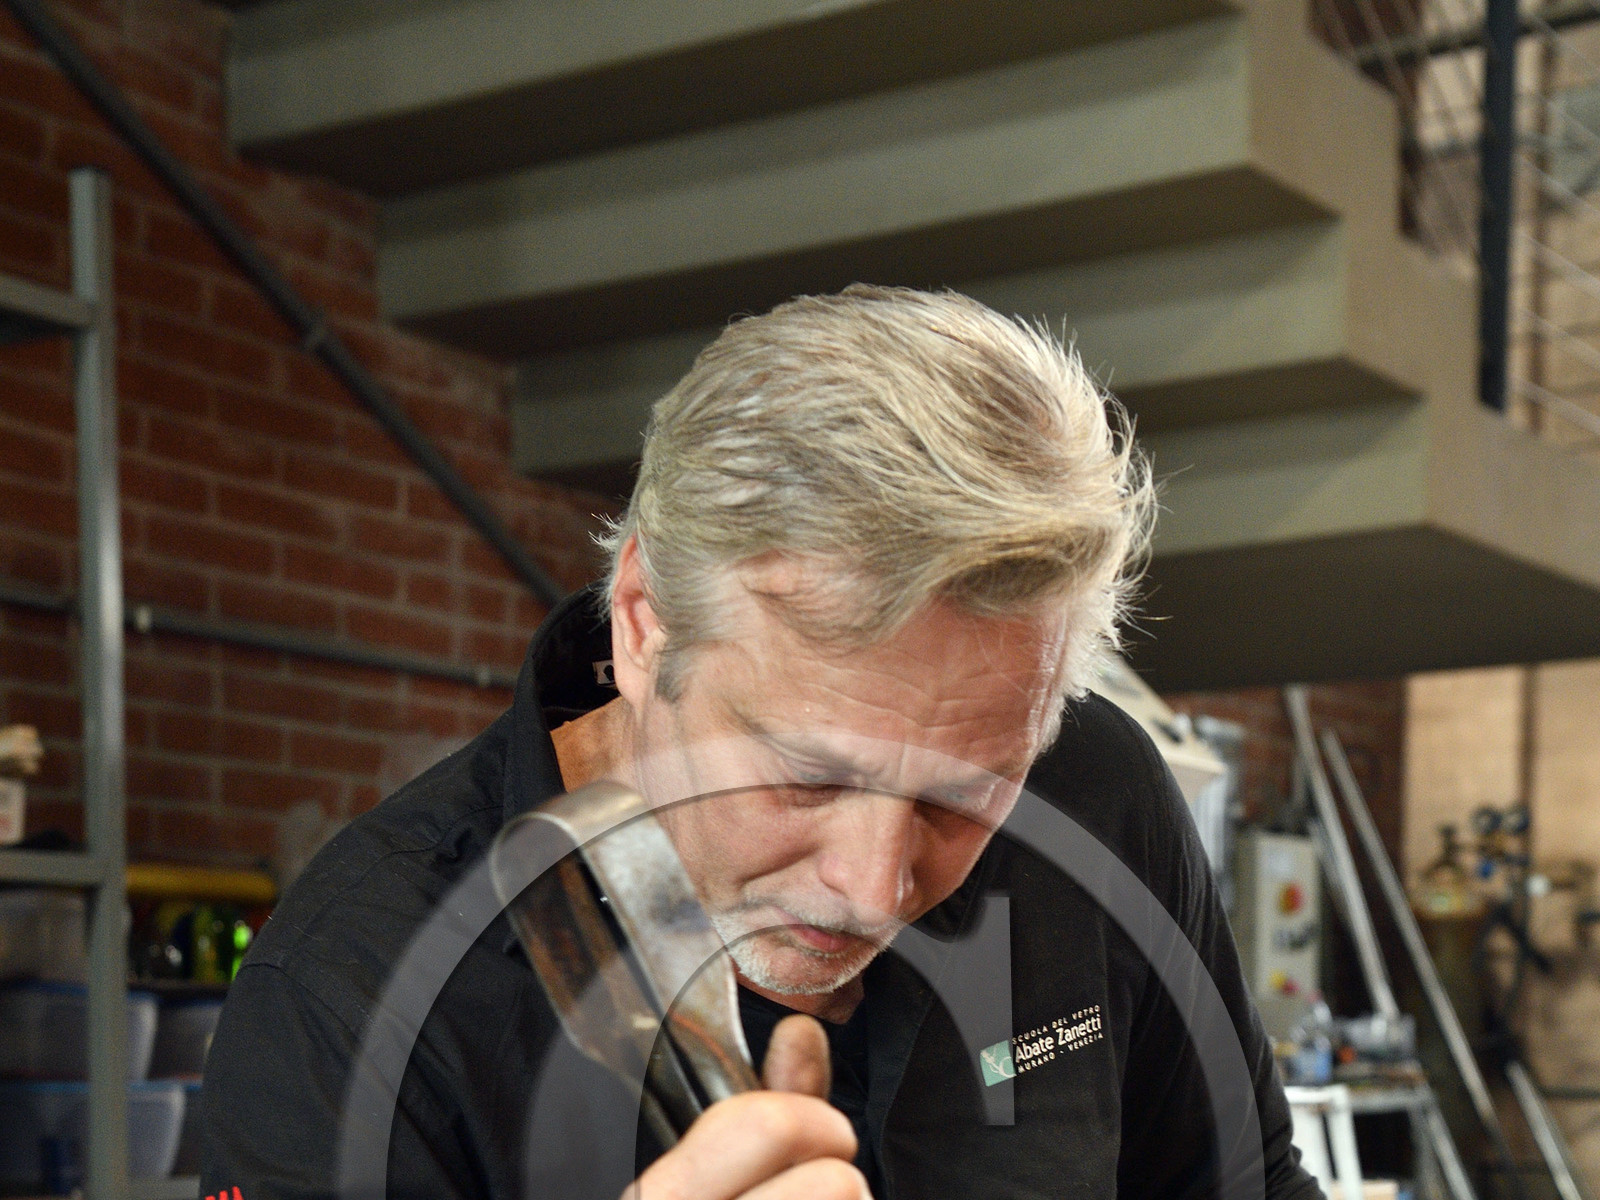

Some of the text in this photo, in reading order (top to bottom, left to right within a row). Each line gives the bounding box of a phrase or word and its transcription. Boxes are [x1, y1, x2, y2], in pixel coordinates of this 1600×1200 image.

[1012, 1004, 1100, 1044] SCUOLA DEL VETRO
[1015, 1014, 1102, 1063] Abate Zanetti
[1018, 1052, 1055, 1073] MURANO
[1068, 1032, 1103, 1051] VENEZIA
